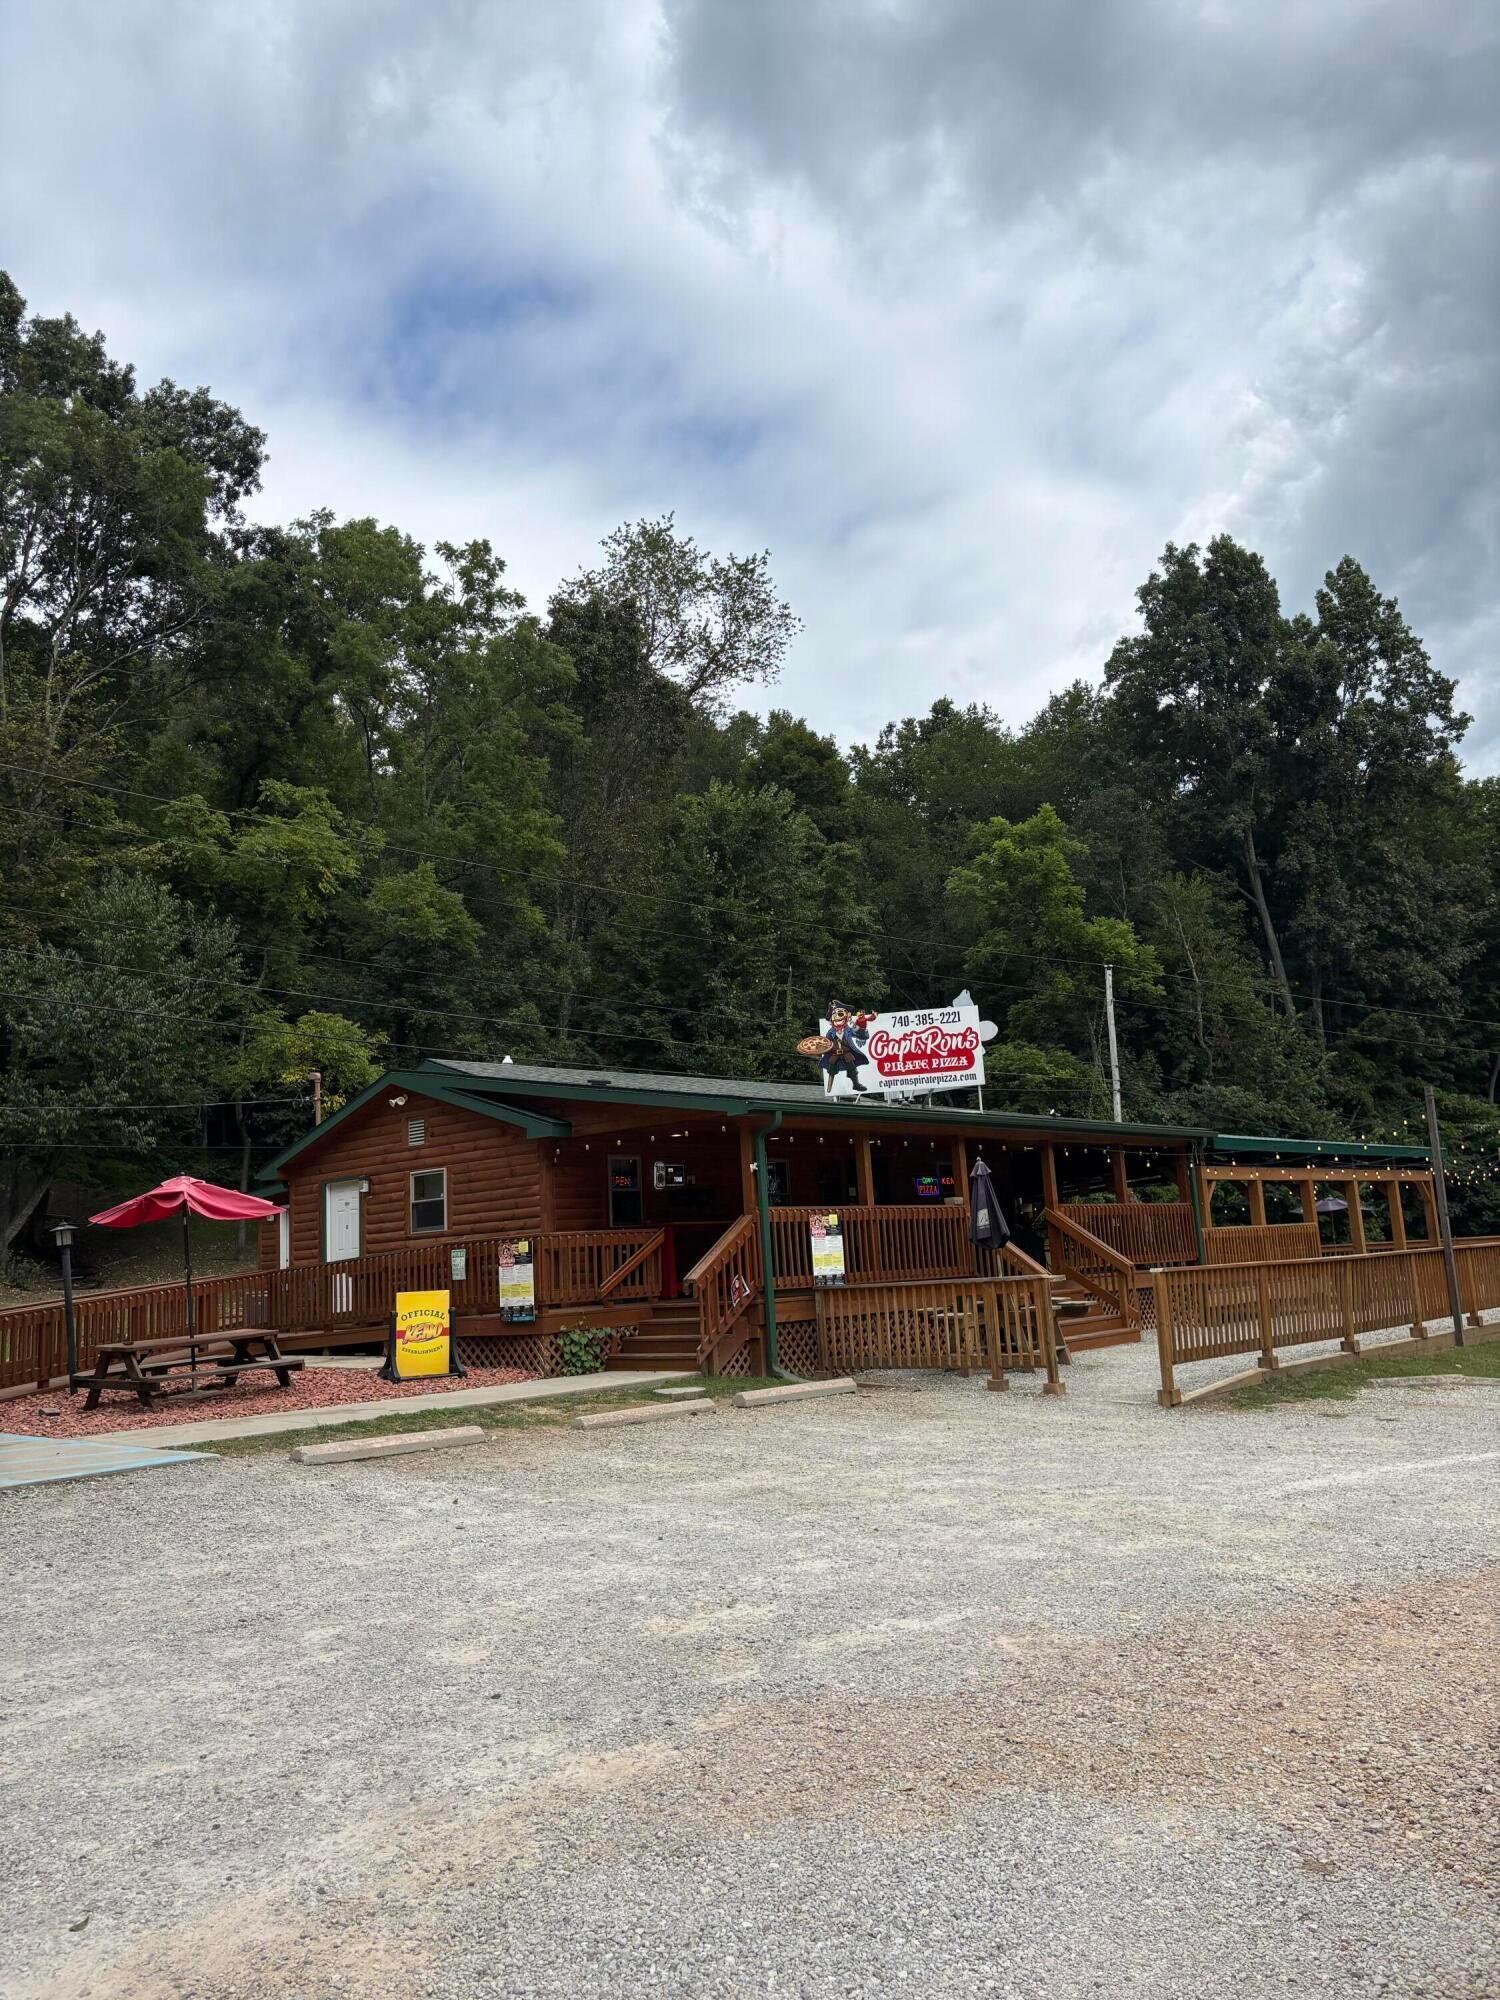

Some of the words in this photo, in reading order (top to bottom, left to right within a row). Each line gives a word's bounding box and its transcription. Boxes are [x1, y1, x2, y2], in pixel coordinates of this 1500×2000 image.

[891, 1010, 961, 1029] 740-385-2221
[870, 1030, 922, 1062] Capt.
[919, 1026, 979, 1056] Ron's
[883, 1058, 930, 1073] PIRATE
[931, 1055, 969, 1069] PIZZA
[878, 1072, 978, 1089] captronspiratepizza.com
[919, 1185, 938, 1194] PIZZA
[941, 1177, 955, 1185] KEN
[401, 1309, 446, 1321] OFFICIAL
[402, 1322, 444, 1345] KENO
[401, 1344, 444, 1355] ESTABLISHMENT
